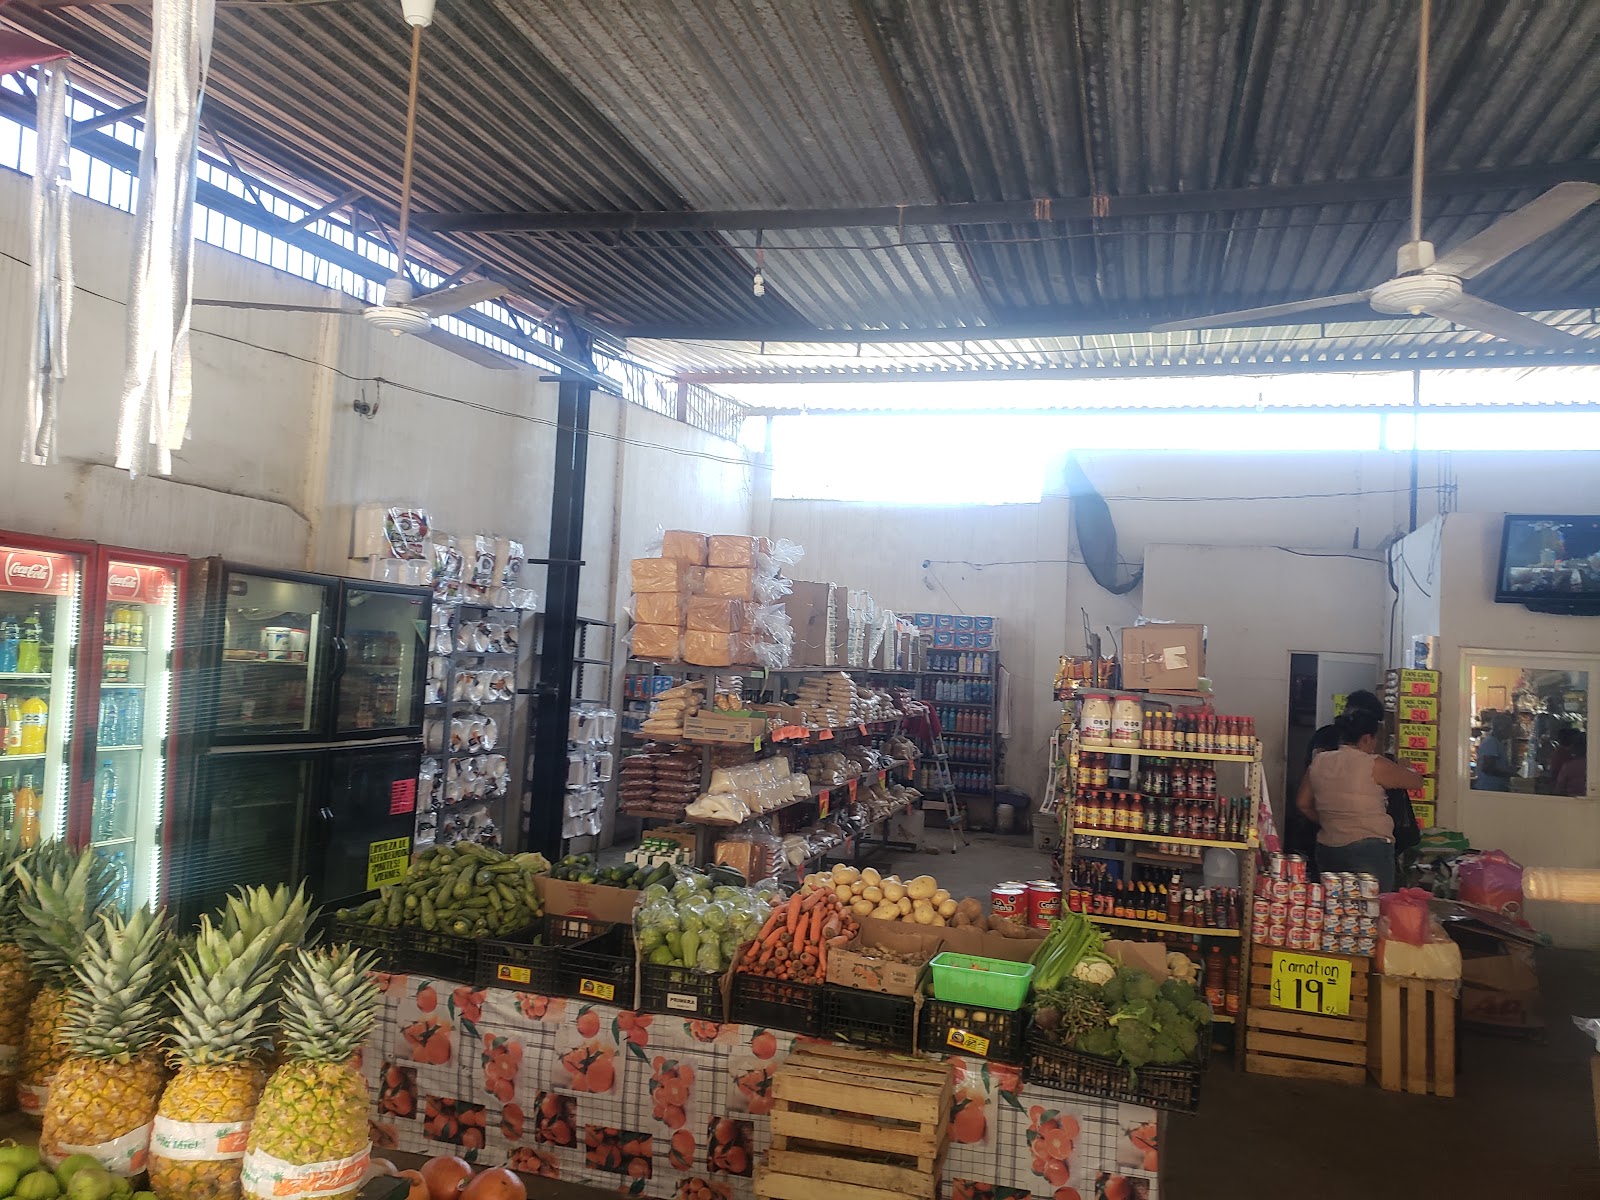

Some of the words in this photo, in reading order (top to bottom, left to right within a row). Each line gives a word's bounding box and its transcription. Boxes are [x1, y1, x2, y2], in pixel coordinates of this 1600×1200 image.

[1413, 683, 1428, 694] 57
[1412, 708, 1427, 719] 50
[1410, 736, 1426, 748] 25
[1292, 978, 1323, 1013] 19
